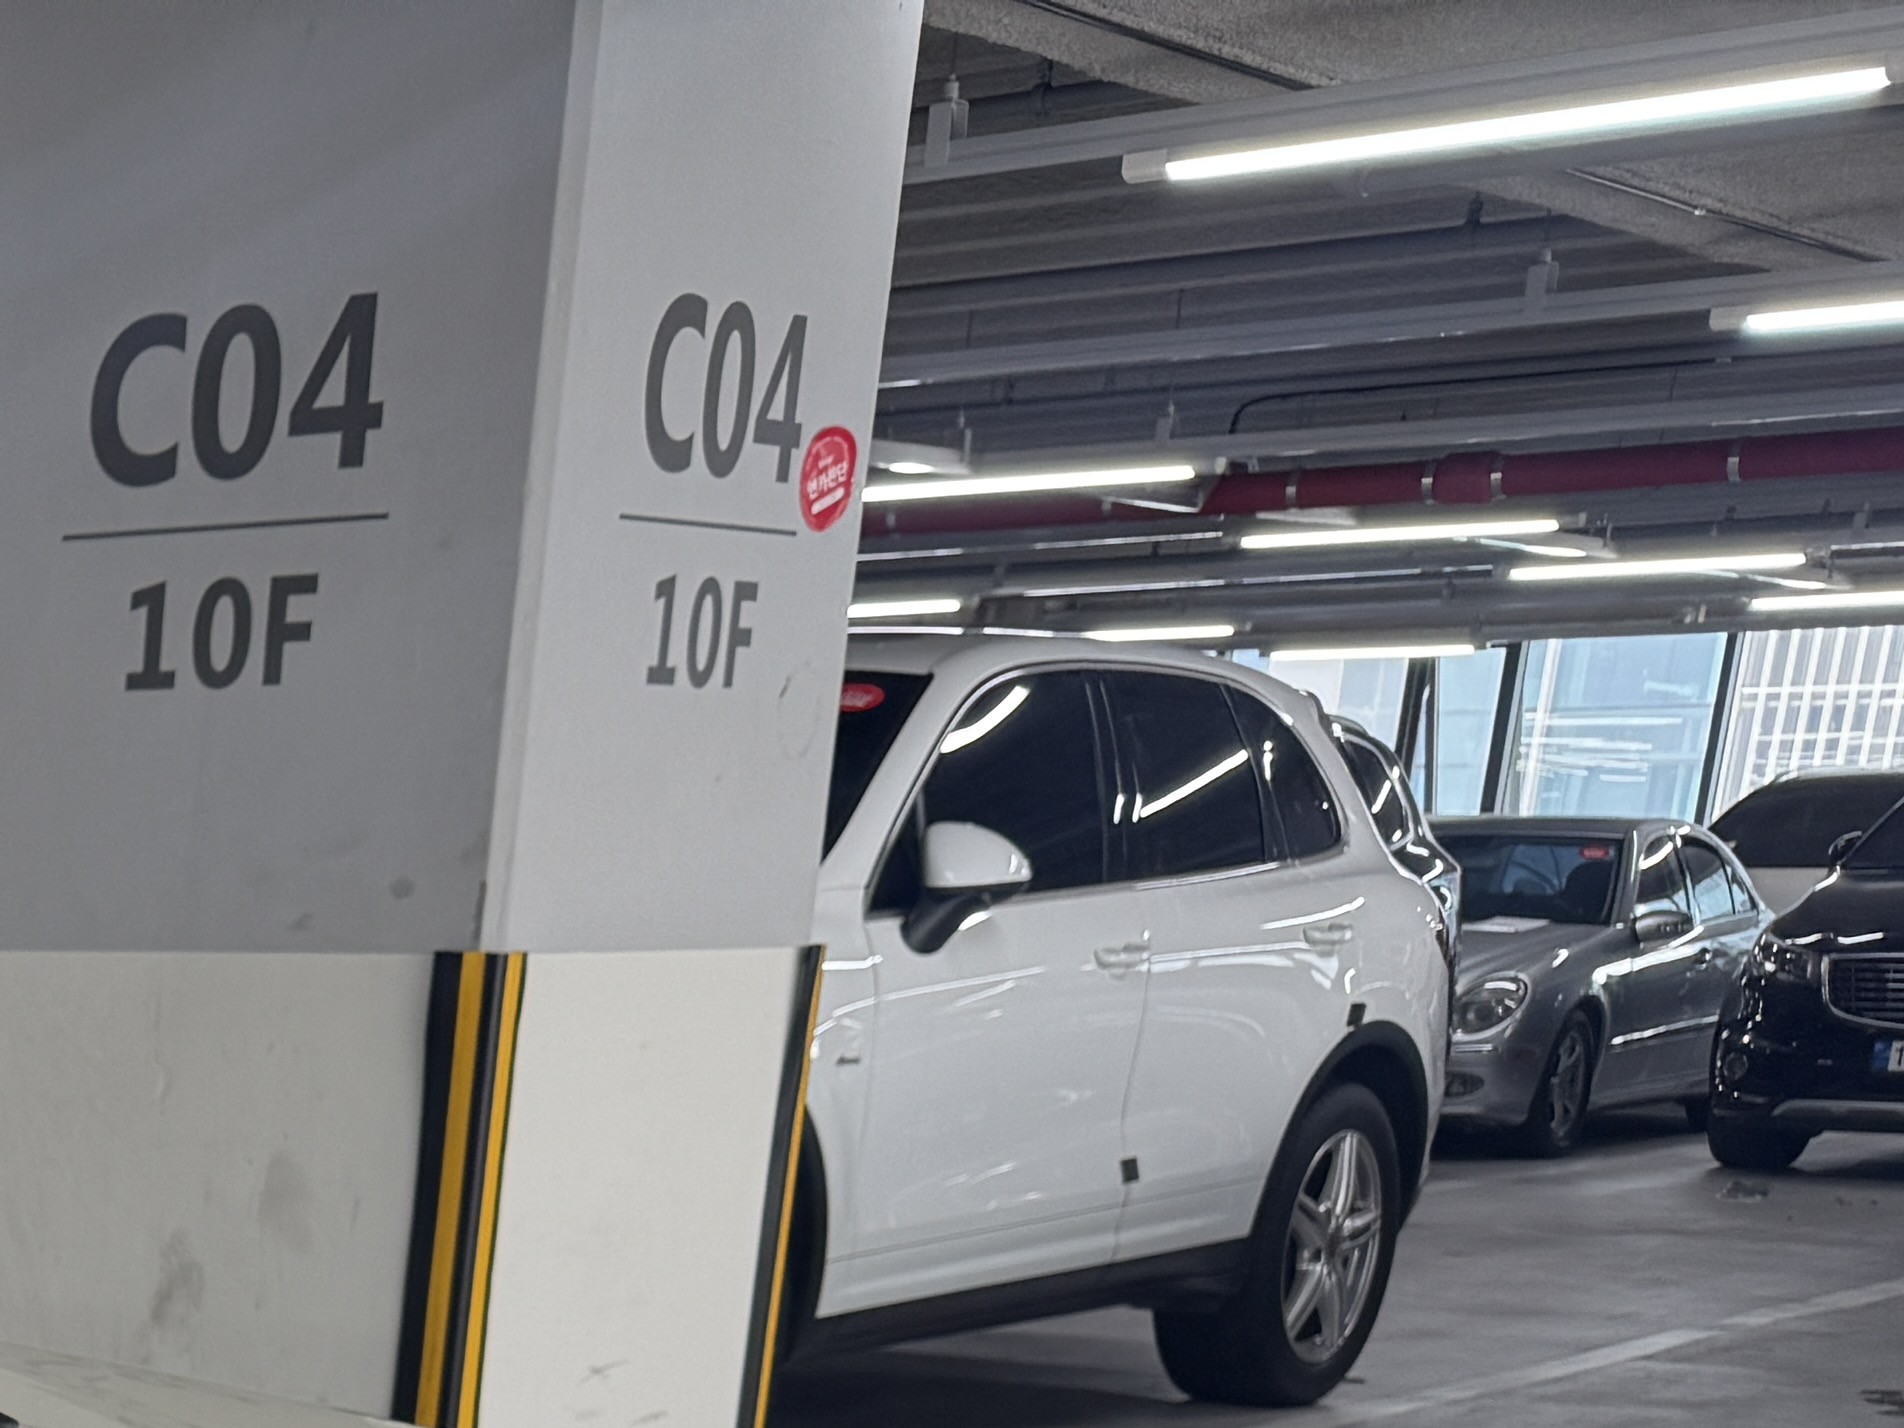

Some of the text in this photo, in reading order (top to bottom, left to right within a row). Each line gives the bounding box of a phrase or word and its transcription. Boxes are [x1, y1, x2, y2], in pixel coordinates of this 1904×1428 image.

[90, 291, 384, 488] C04
[645, 293, 808, 484] C04
[125, 573, 319, 691] 10F
[646, 574, 759, 689] 10F
